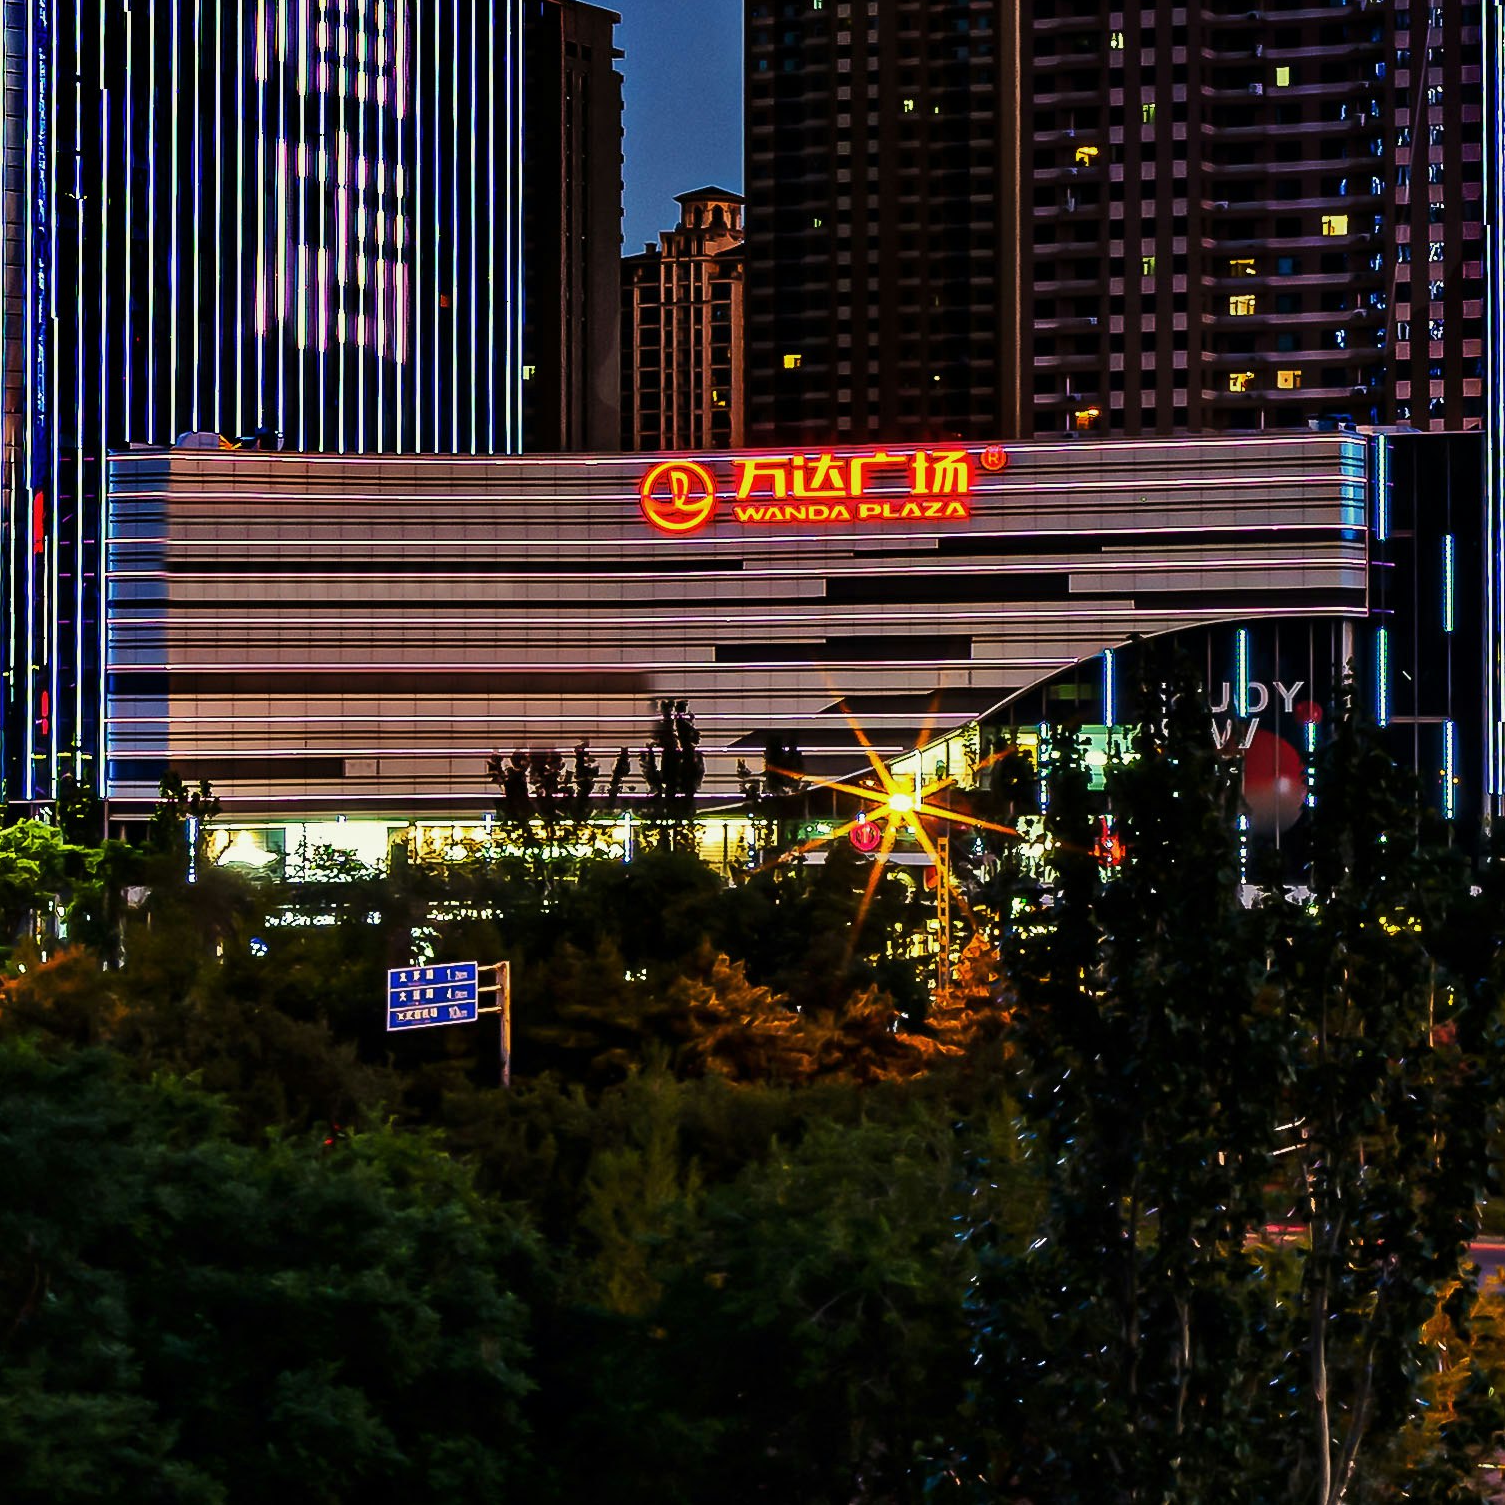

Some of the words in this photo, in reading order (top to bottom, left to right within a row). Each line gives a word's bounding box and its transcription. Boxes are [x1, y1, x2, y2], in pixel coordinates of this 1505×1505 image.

[732, 450, 969, 499] 万达广场
[734, 503, 848, 522] WANDA
[858, 500, 967, 519] PLAZA
